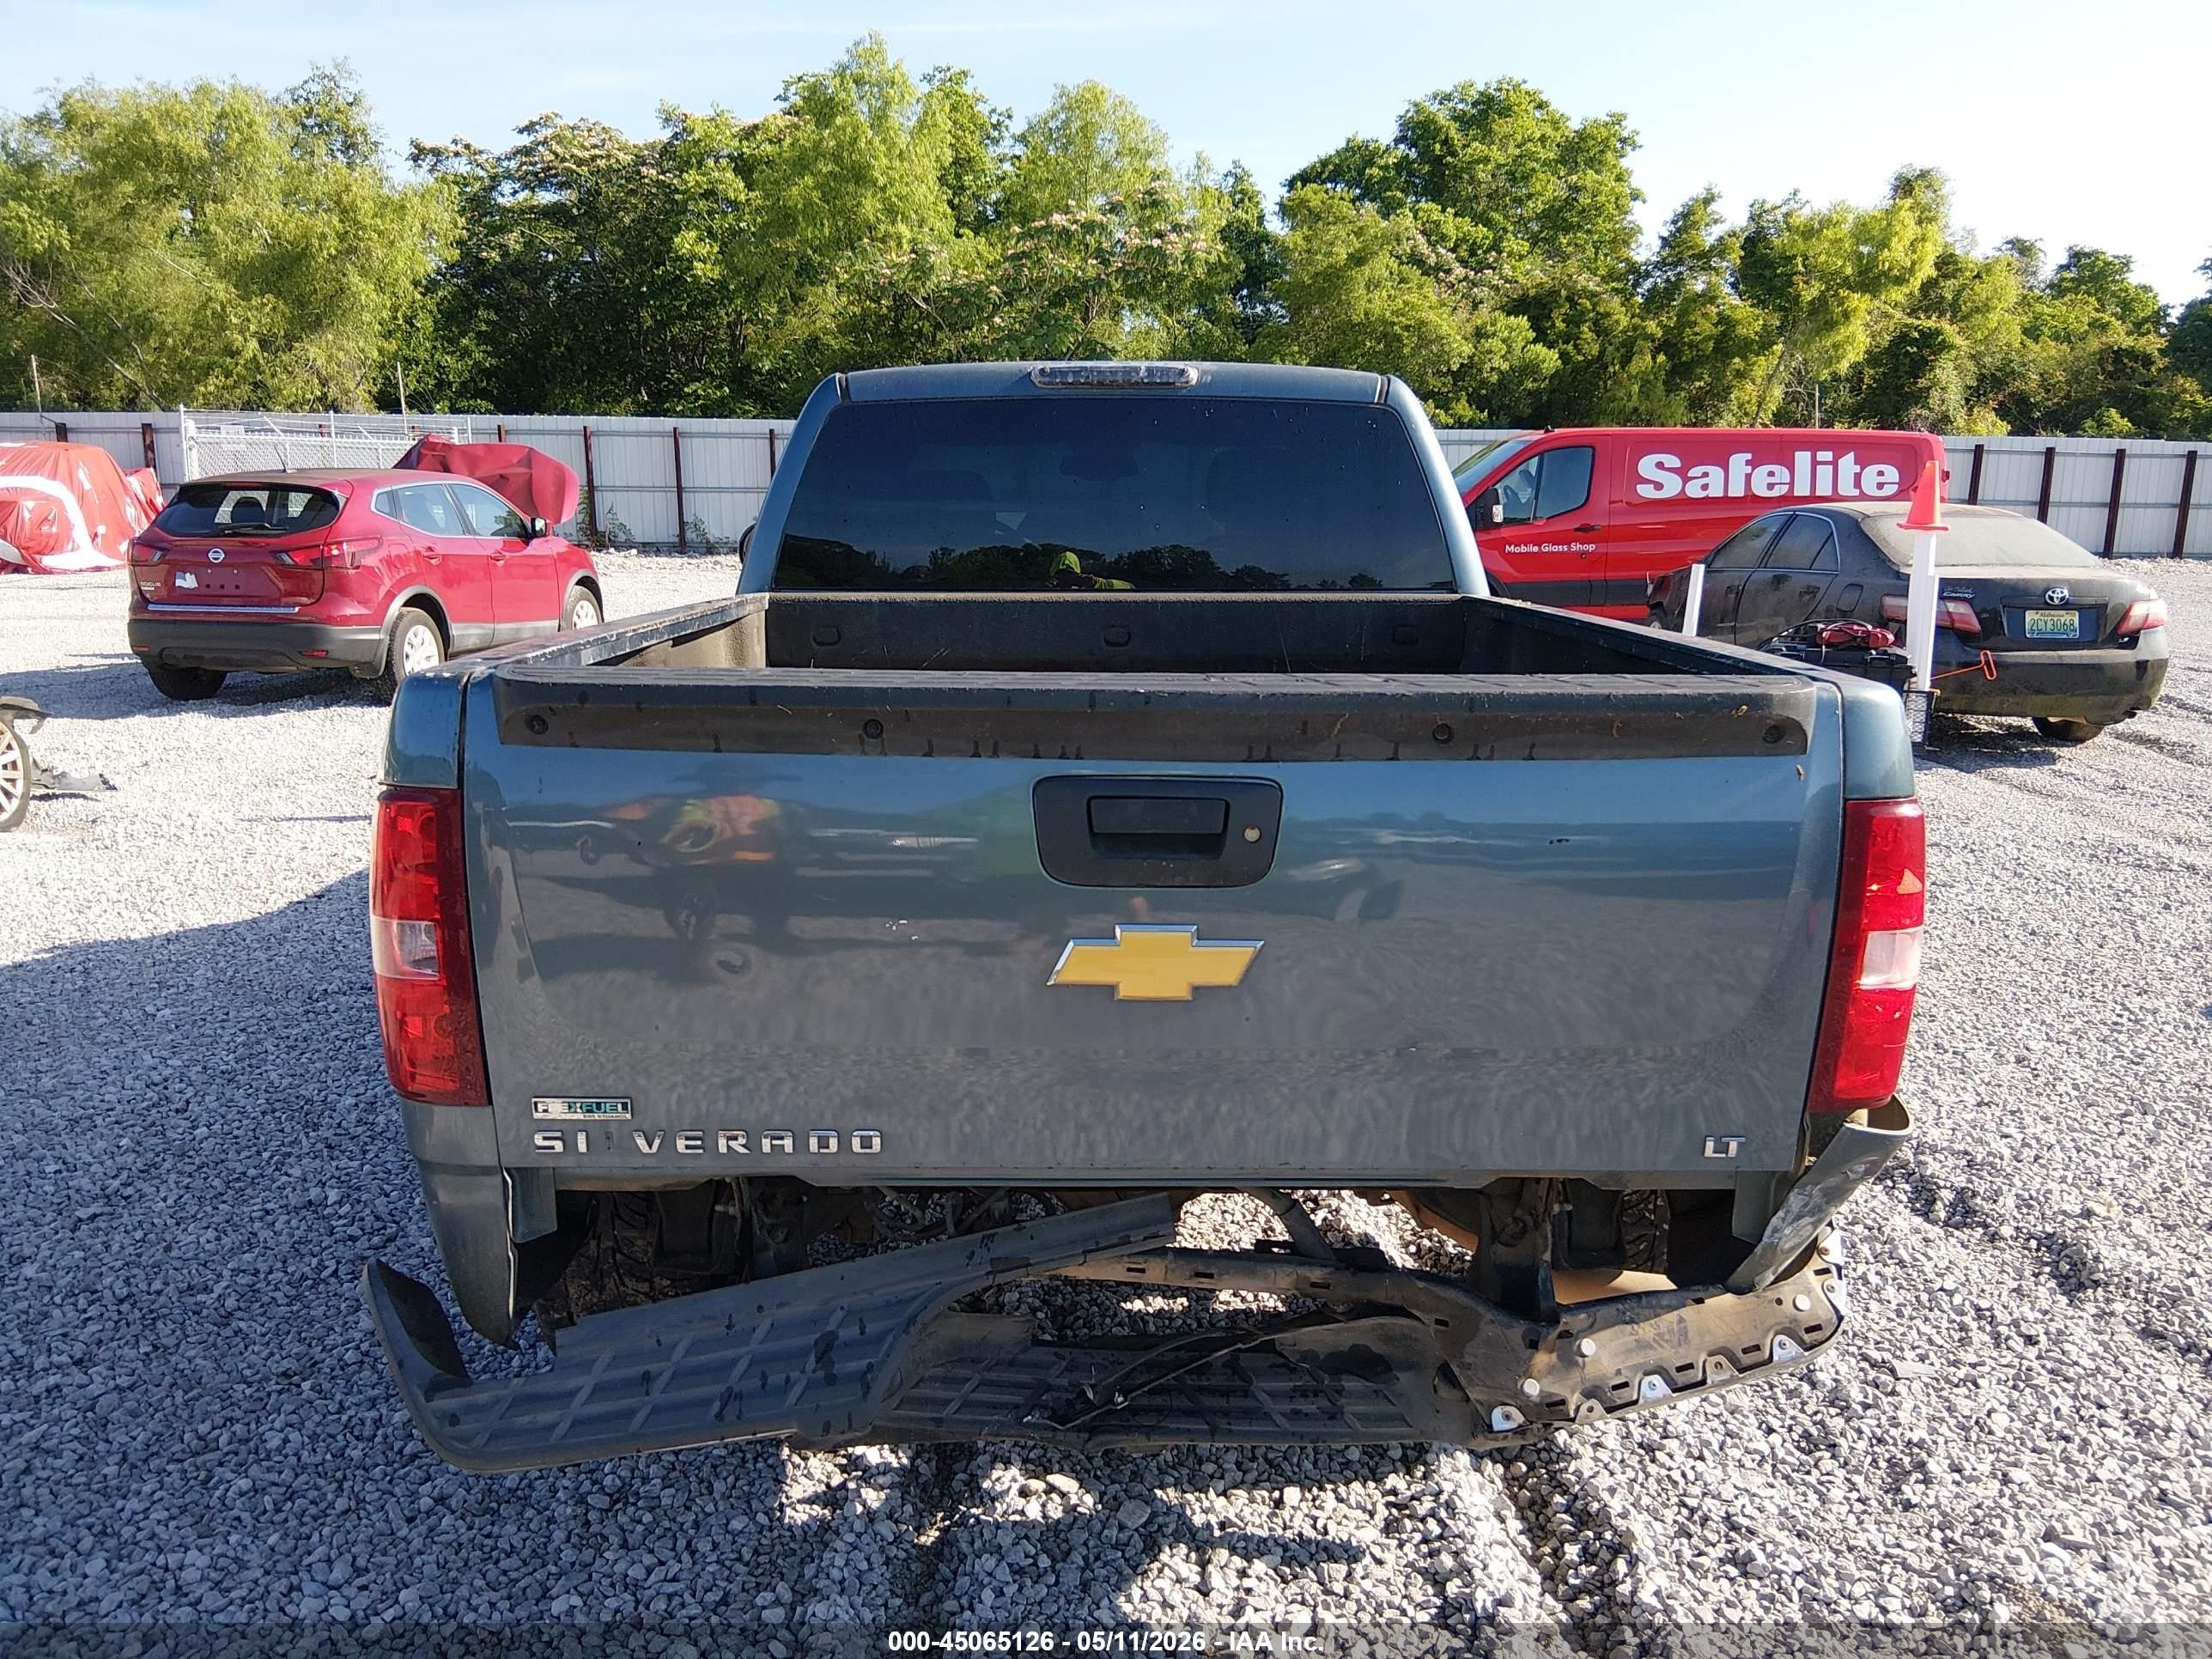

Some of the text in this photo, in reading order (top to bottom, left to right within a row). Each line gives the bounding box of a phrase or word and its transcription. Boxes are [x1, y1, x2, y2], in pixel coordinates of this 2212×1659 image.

[1636, 451, 1899, 499] Safelite
[1505, 542, 1595, 553] Mobile Glass Shop
[2029, 618, 2075, 632] 2CY3068
[1704, 1136, 1746, 1158] LT
